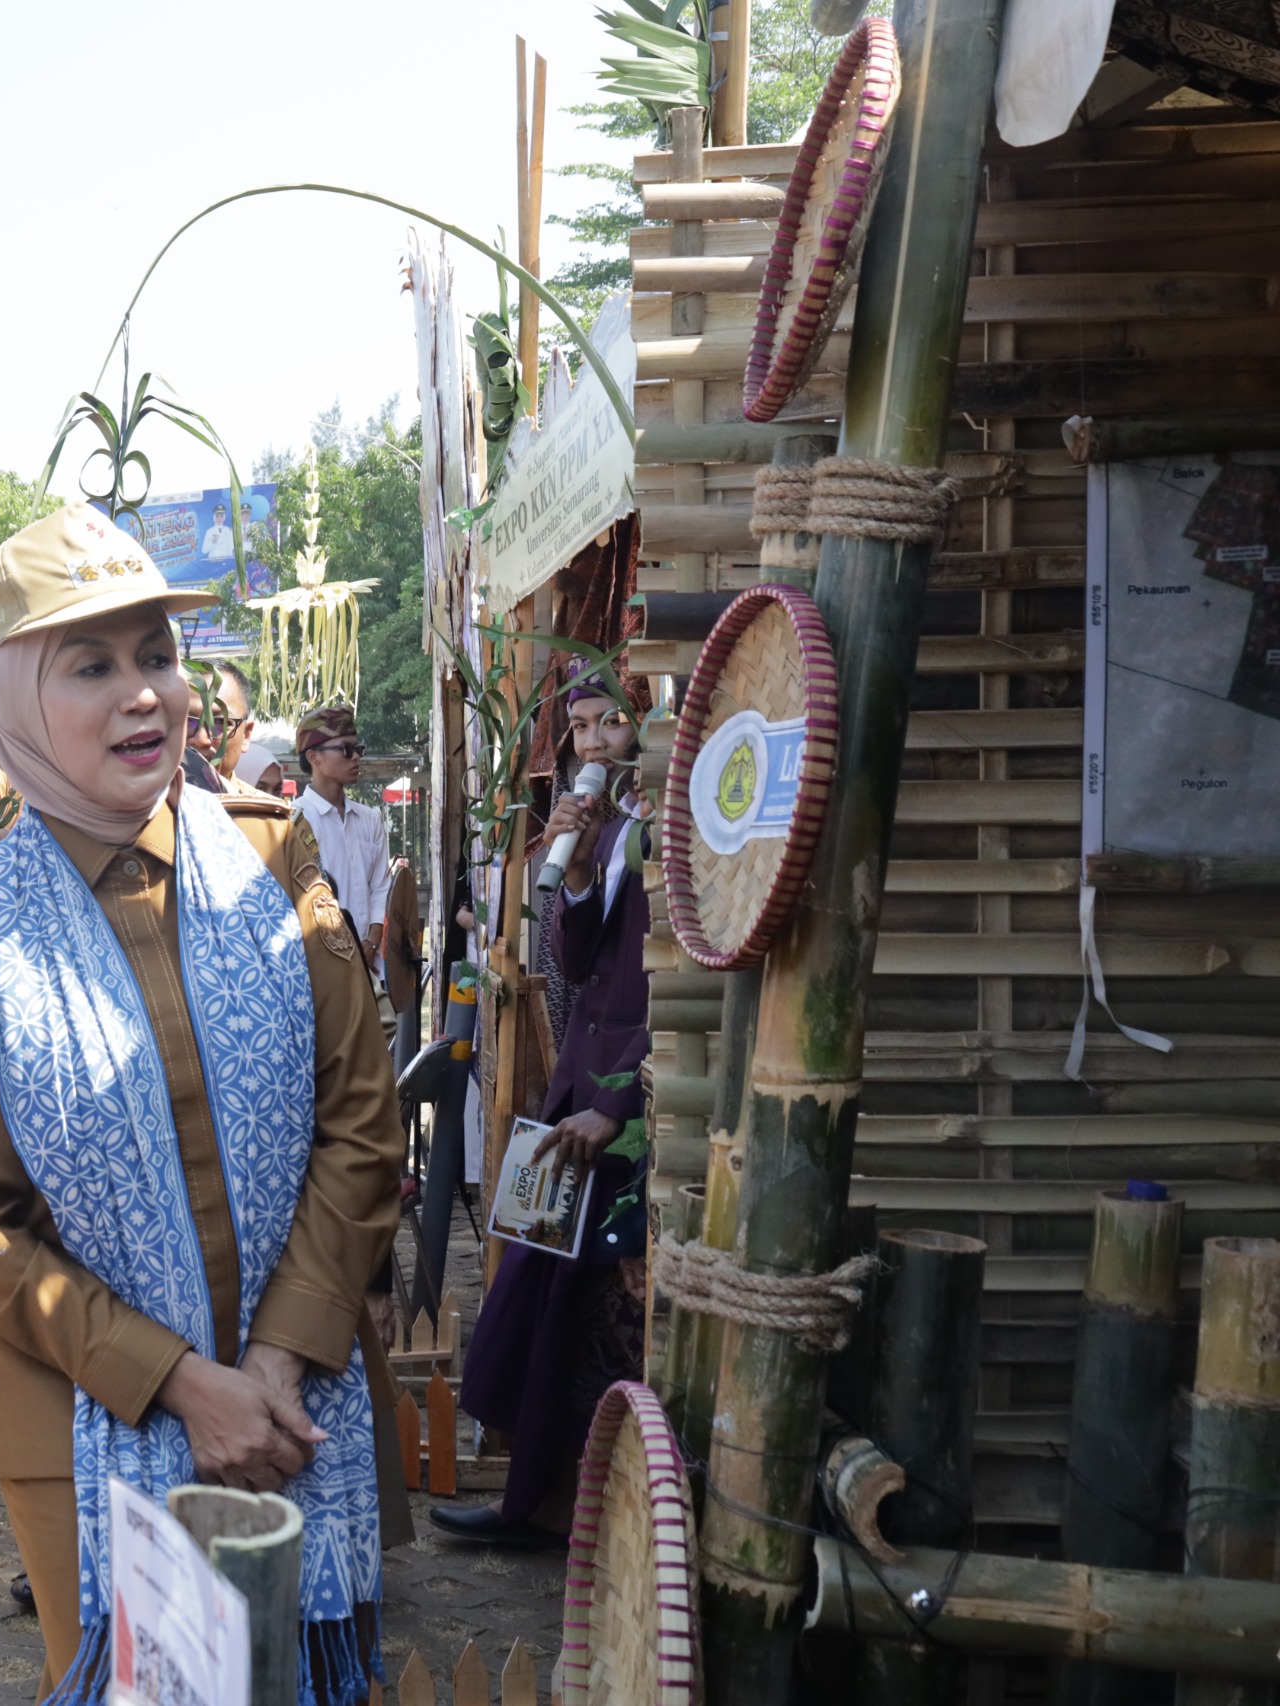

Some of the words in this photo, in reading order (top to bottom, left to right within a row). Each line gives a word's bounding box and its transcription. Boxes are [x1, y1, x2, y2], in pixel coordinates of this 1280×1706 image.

[1173, 467, 1206, 479] Balok
[495, 500, 528, 558] EXPO
[530, 470, 558, 524] KKN
[558, 427, 589, 493] PPM
[526, 508, 562, 556] Universitas
[562, 469, 600, 524] Semarang
[581, 499, 603, 528] Wetan
[1128, 584, 1191, 596] Pekauman
[1181, 778, 1228, 790] Pegulon
[516, 1167, 531, 1198] EXPO
[527, 1180, 536, 1196] PPM
